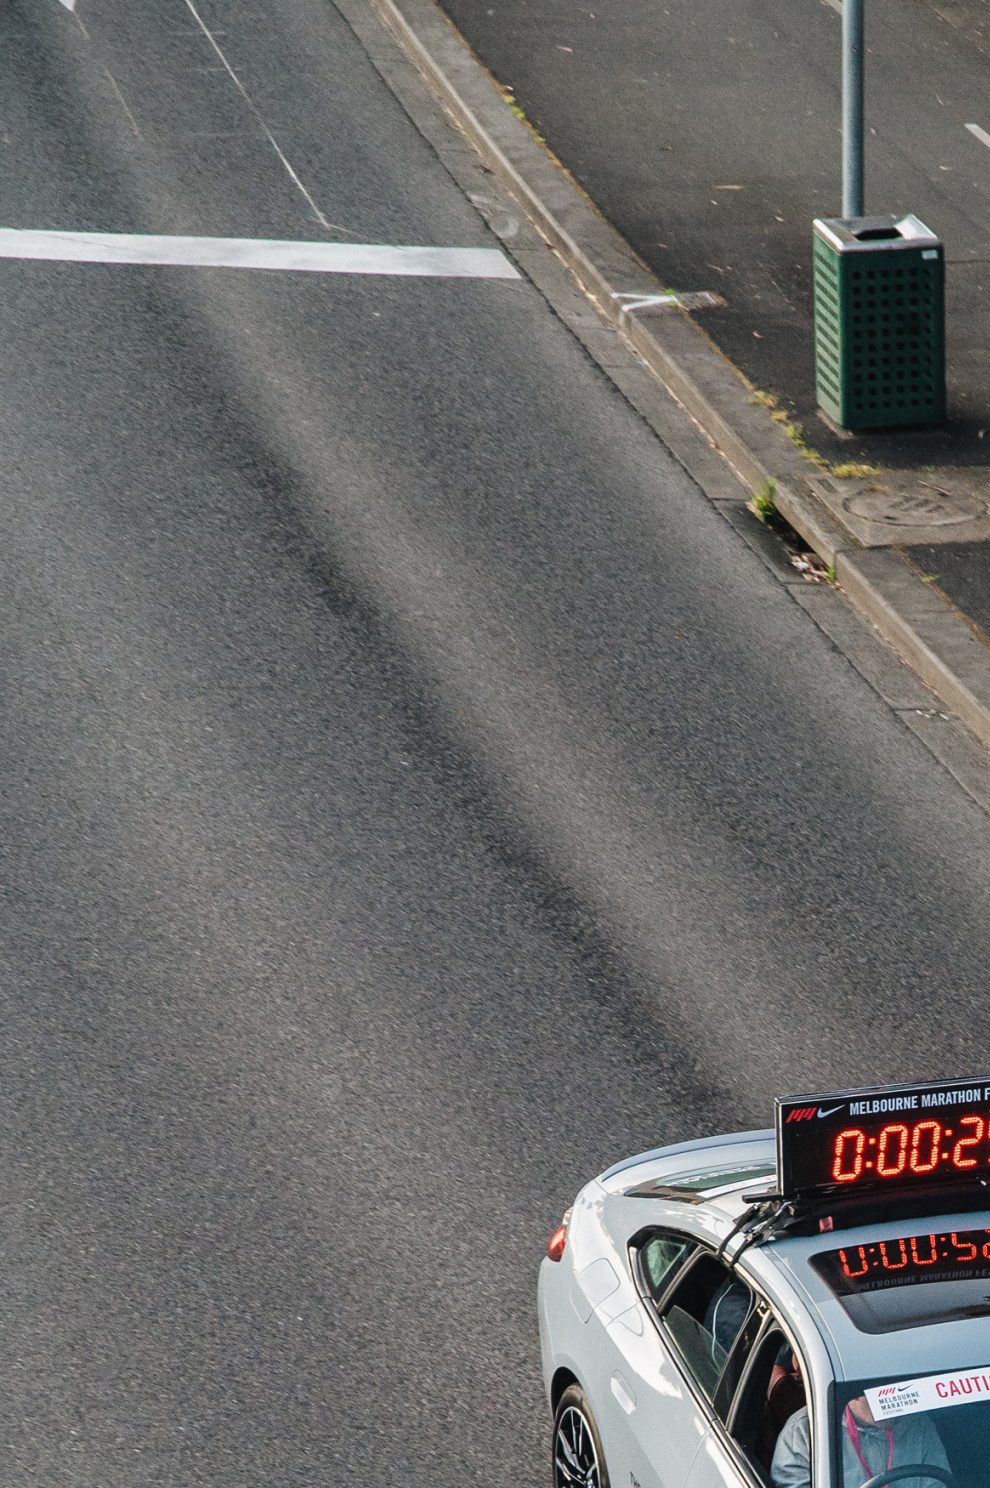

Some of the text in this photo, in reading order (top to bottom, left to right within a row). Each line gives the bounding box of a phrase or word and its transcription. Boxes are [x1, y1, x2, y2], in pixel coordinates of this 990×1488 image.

[849, 1095, 919, 1116] MELBOURNE
[921, 1088, 981, 1108] MARATHON
[879, 1391, 920, 1404] MELBOURNE
[881, 1398, 918, 1410] MARATHON
